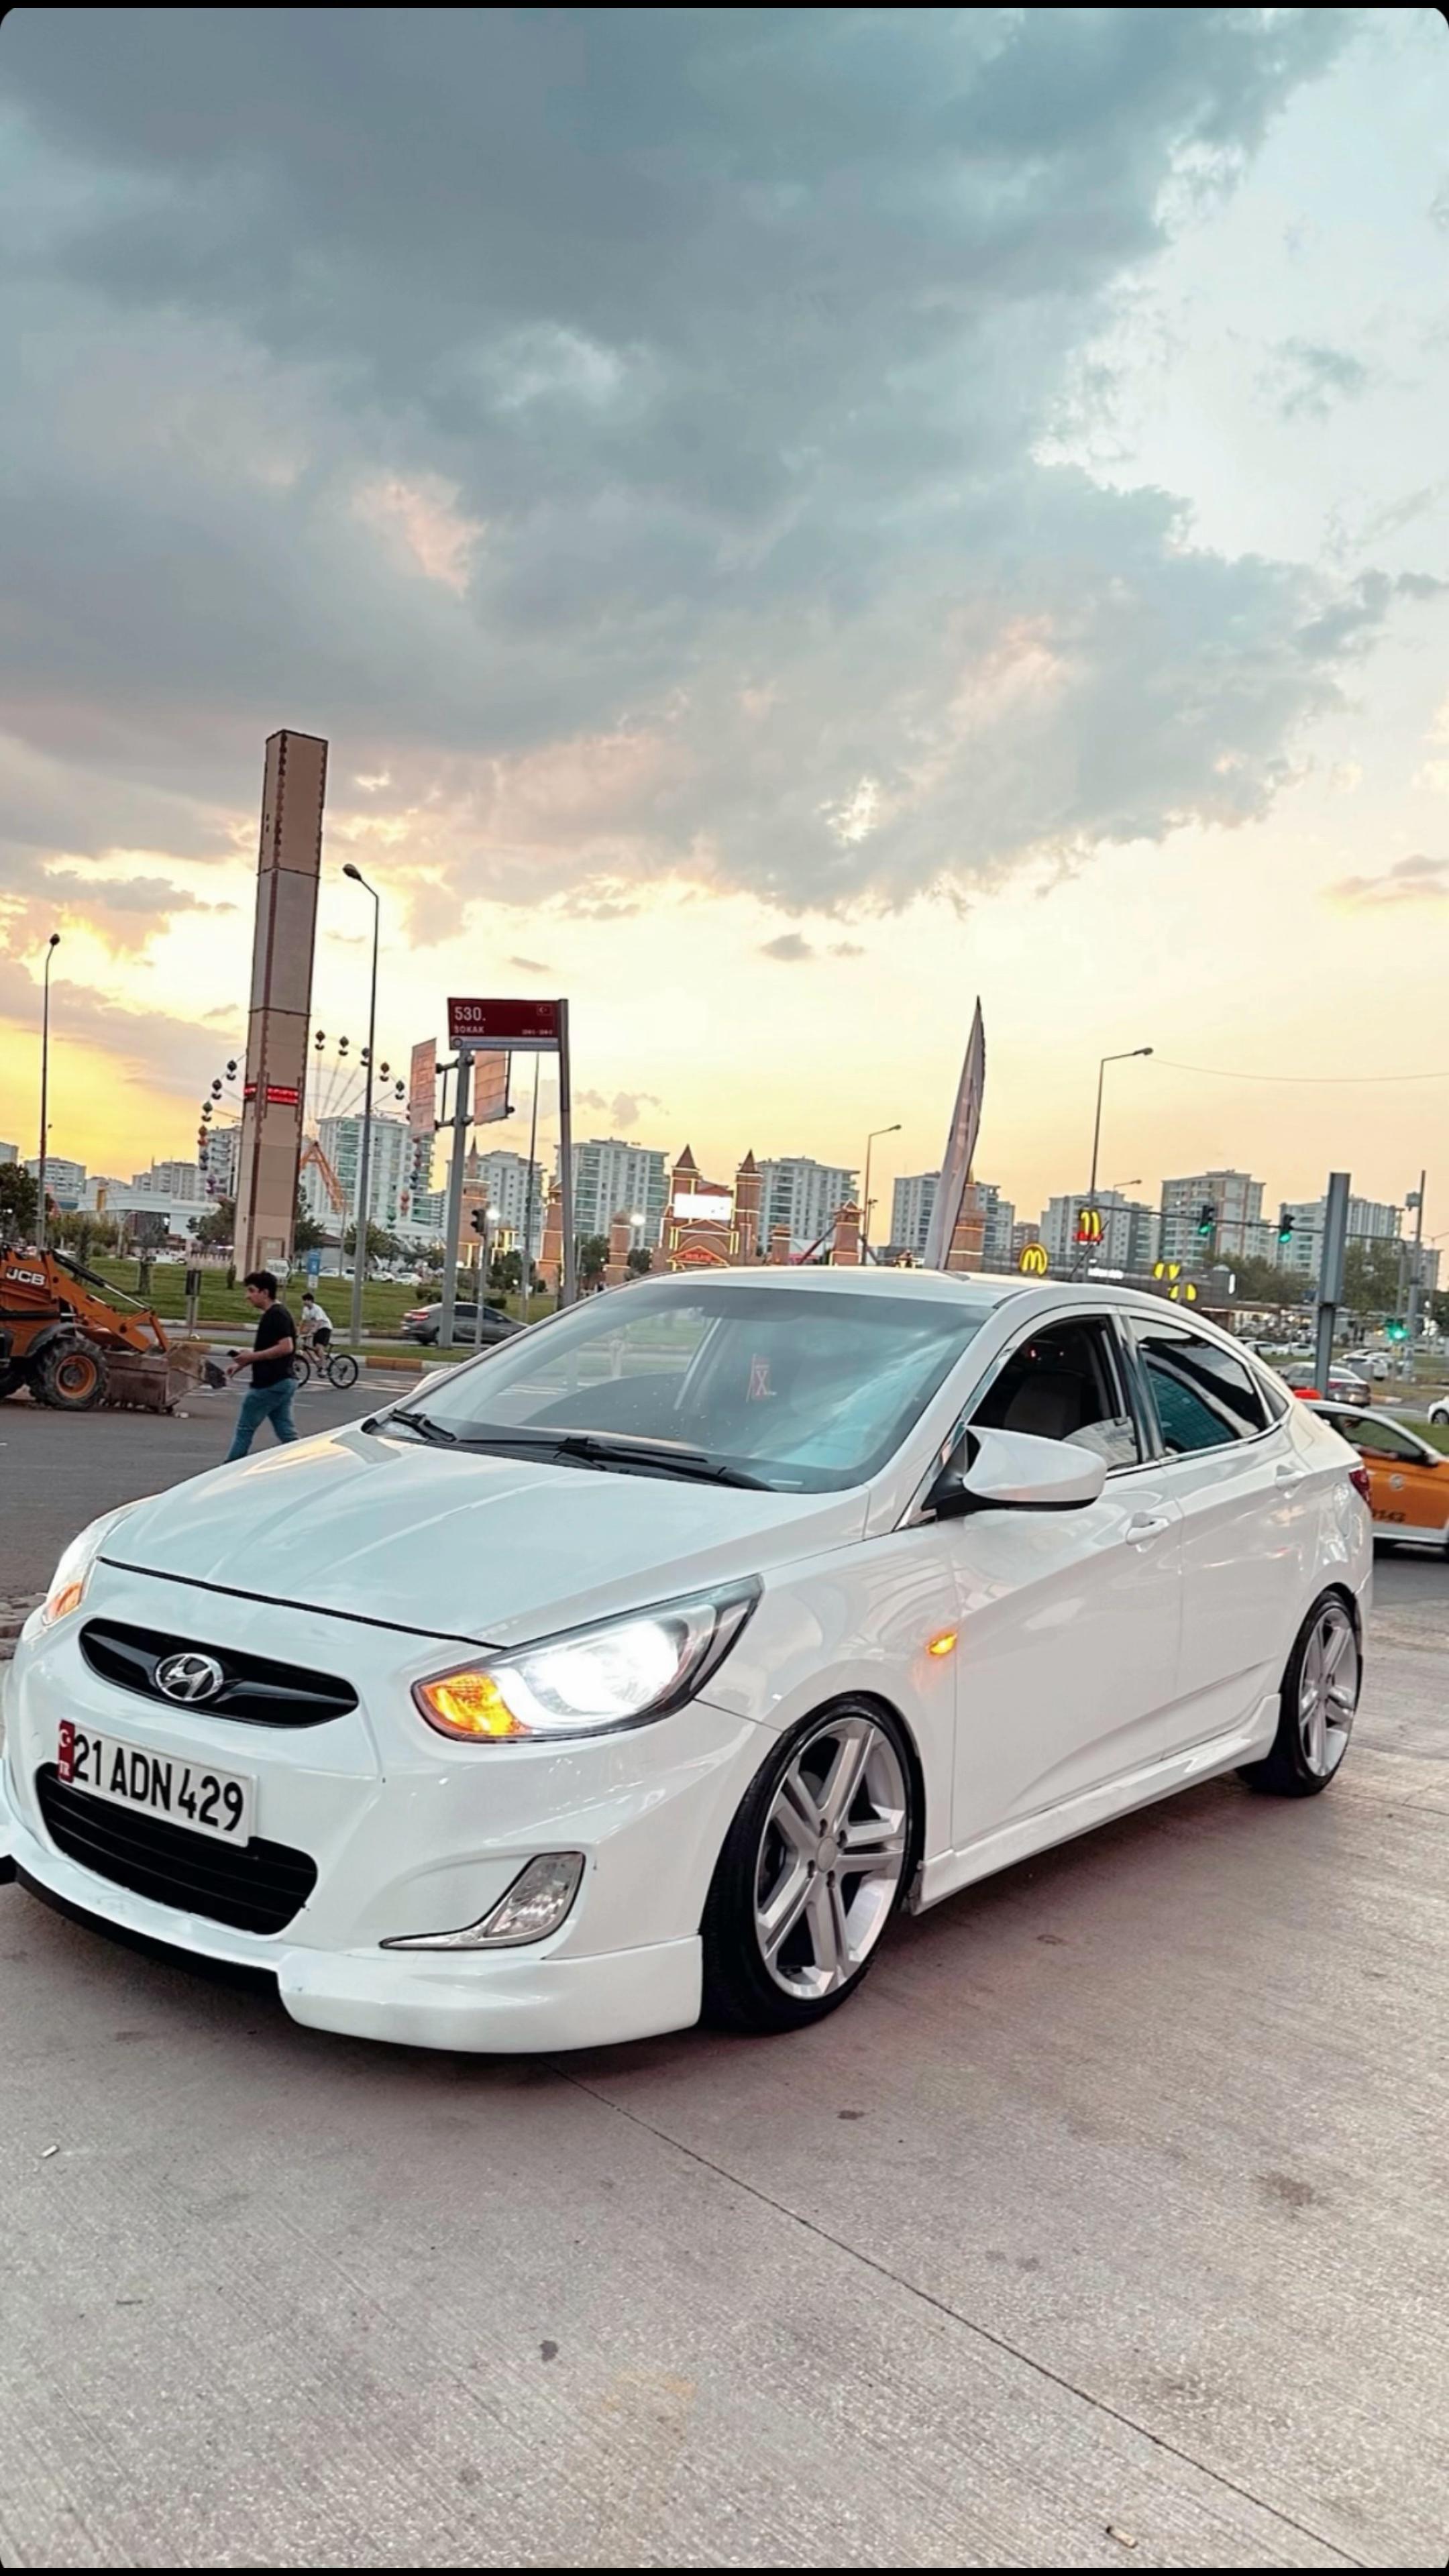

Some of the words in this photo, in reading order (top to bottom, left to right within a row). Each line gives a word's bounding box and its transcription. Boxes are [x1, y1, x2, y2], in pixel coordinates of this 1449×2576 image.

[454, 1006, 486, 1022] 530.
[454, 1025, 484, 1034] SOKAK
[6, 1269, 46, 1286] JCB
[74, 1734, 102, 1786] 21
[110, 1747, 172, 1811] ADN
[178, 1768, 244, 1831] 429
